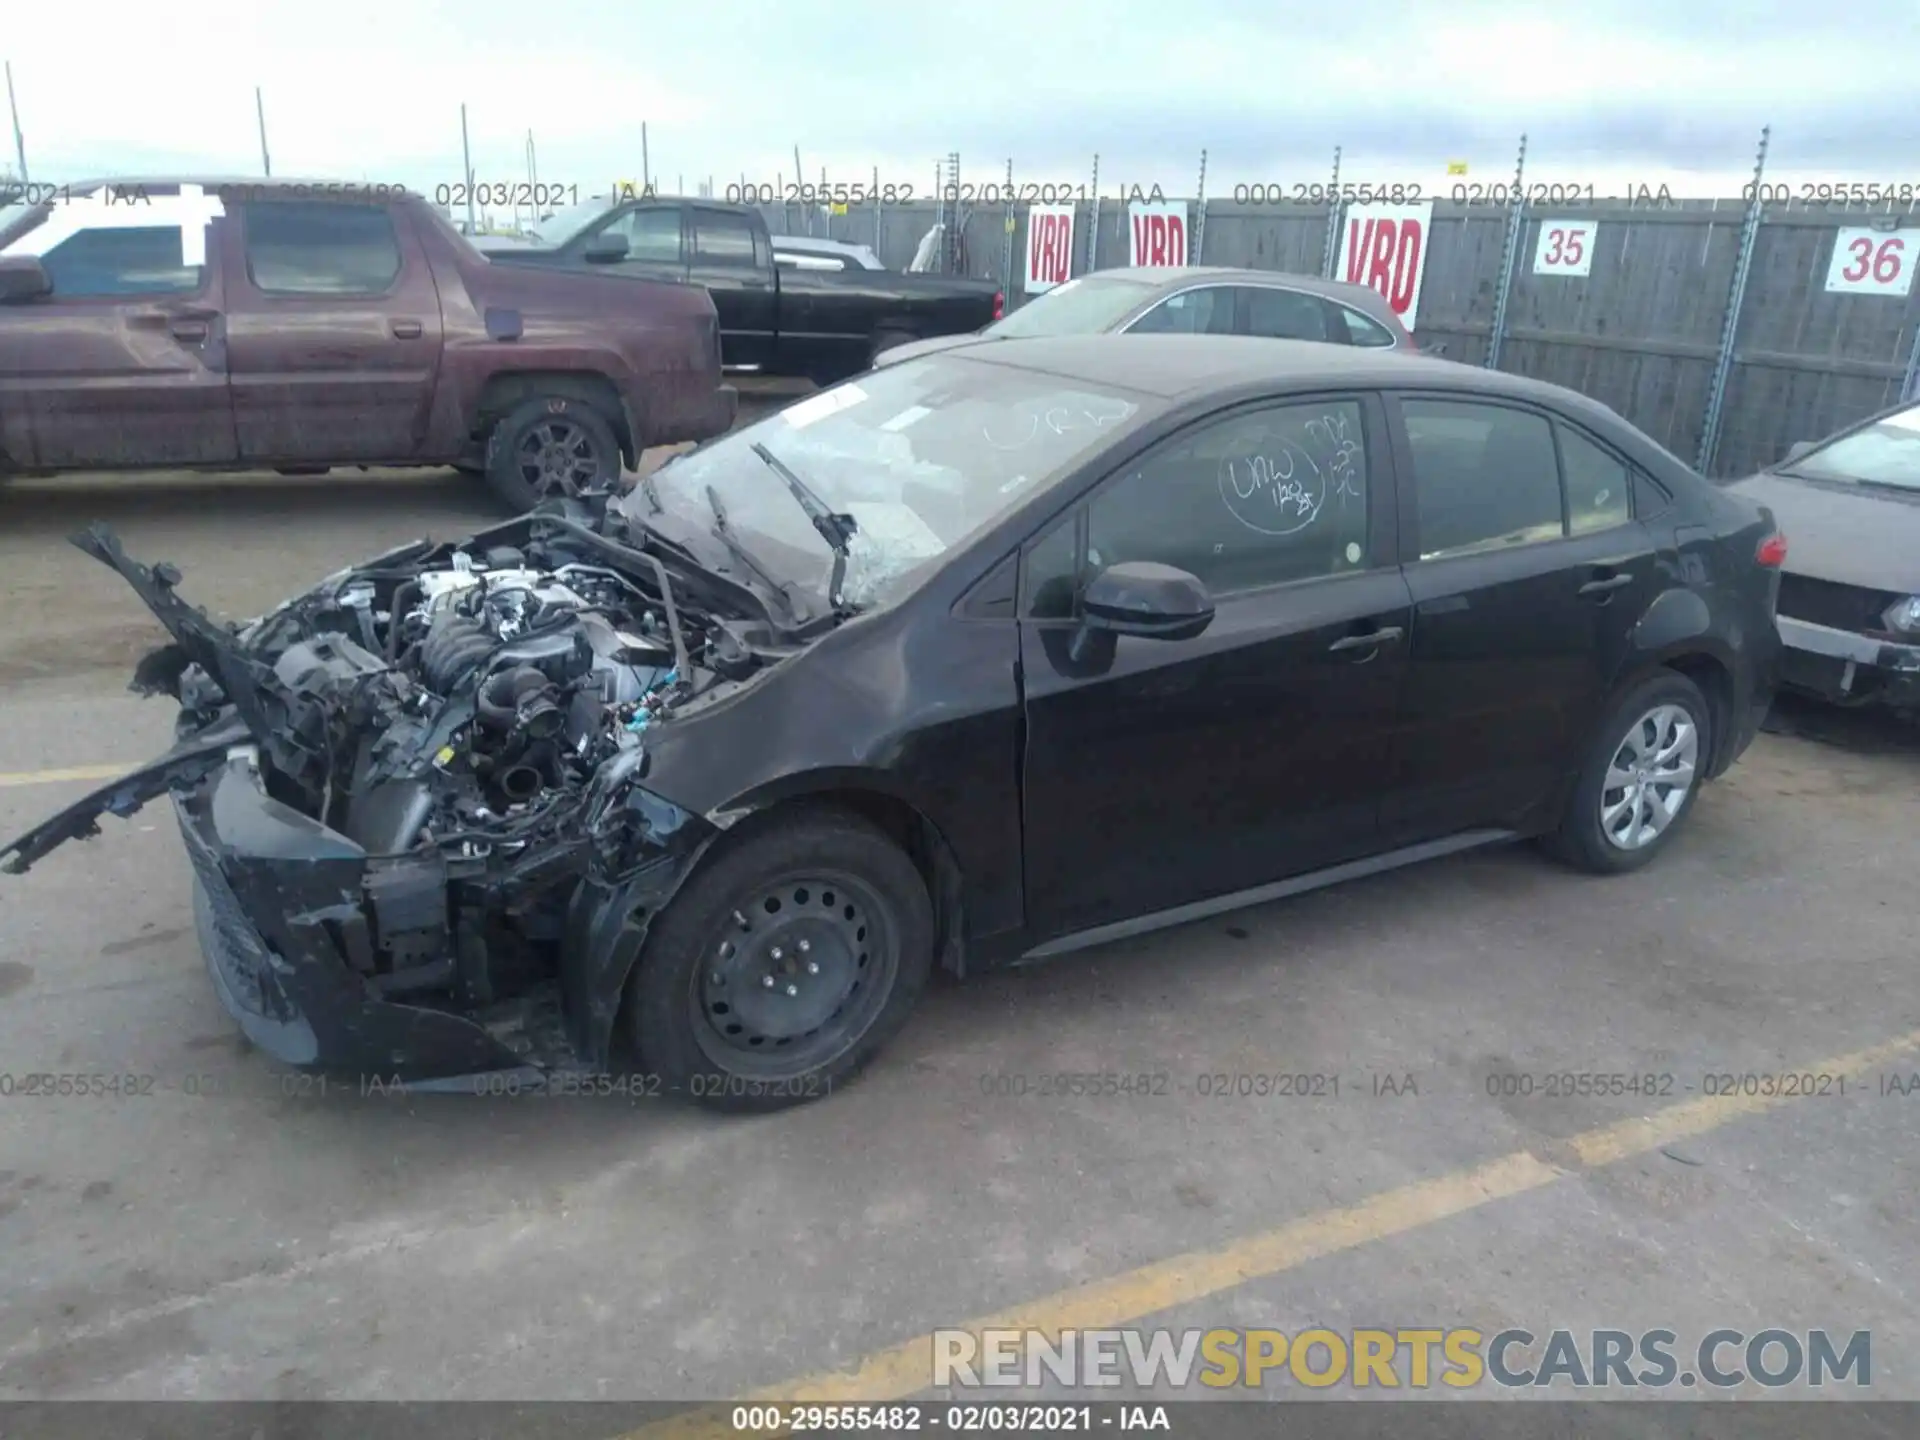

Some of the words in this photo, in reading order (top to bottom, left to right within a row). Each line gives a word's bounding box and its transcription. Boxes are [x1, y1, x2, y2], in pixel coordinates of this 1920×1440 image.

[1031, 214, 1070, 283] VRD
[1134, 214, 1187, 267] VRD
[1347, 218, 1421, 315] VRD
[1544, 229, 1585, 266] 35
[1843, 238, 1904, 284] 36
